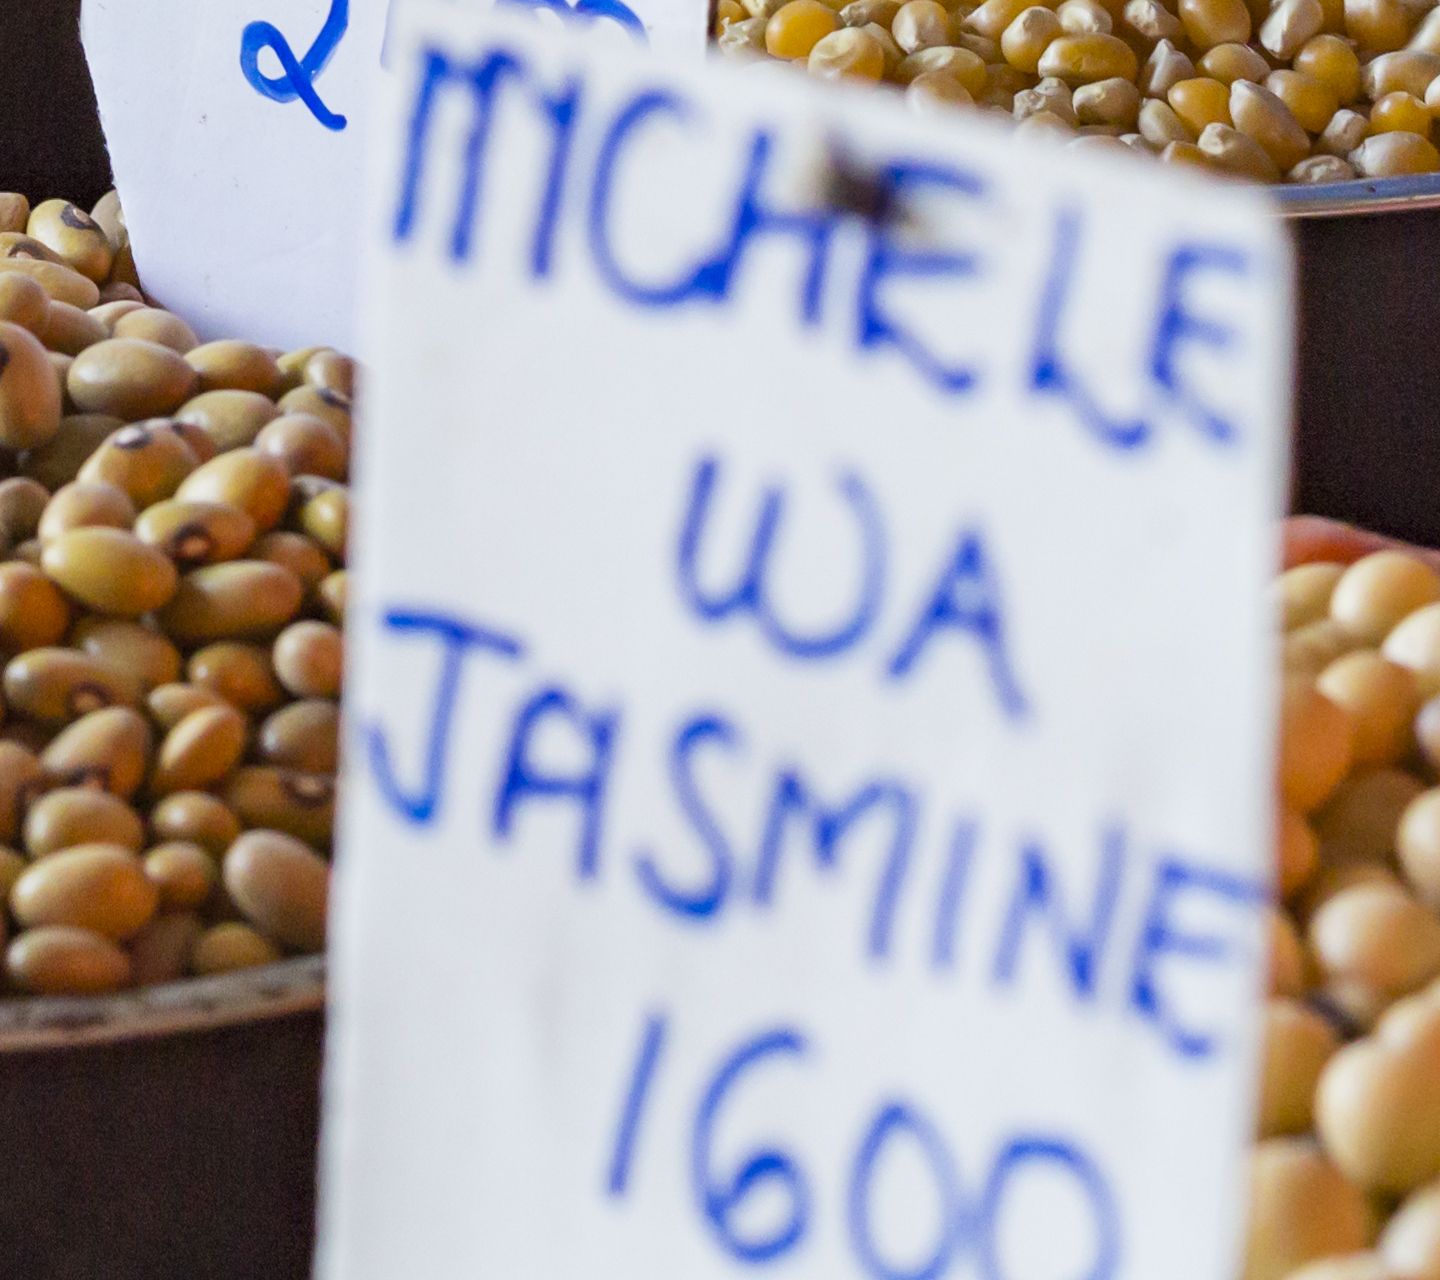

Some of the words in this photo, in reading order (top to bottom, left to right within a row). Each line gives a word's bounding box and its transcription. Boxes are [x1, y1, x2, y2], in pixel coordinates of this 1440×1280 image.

[392, 39, 1258, 458] MCHELE
[672, 442, 1038, 725] WA
[365, 605, 1272, 1065] JASMINE
[604, 1003, 1122, 1280] 1600
